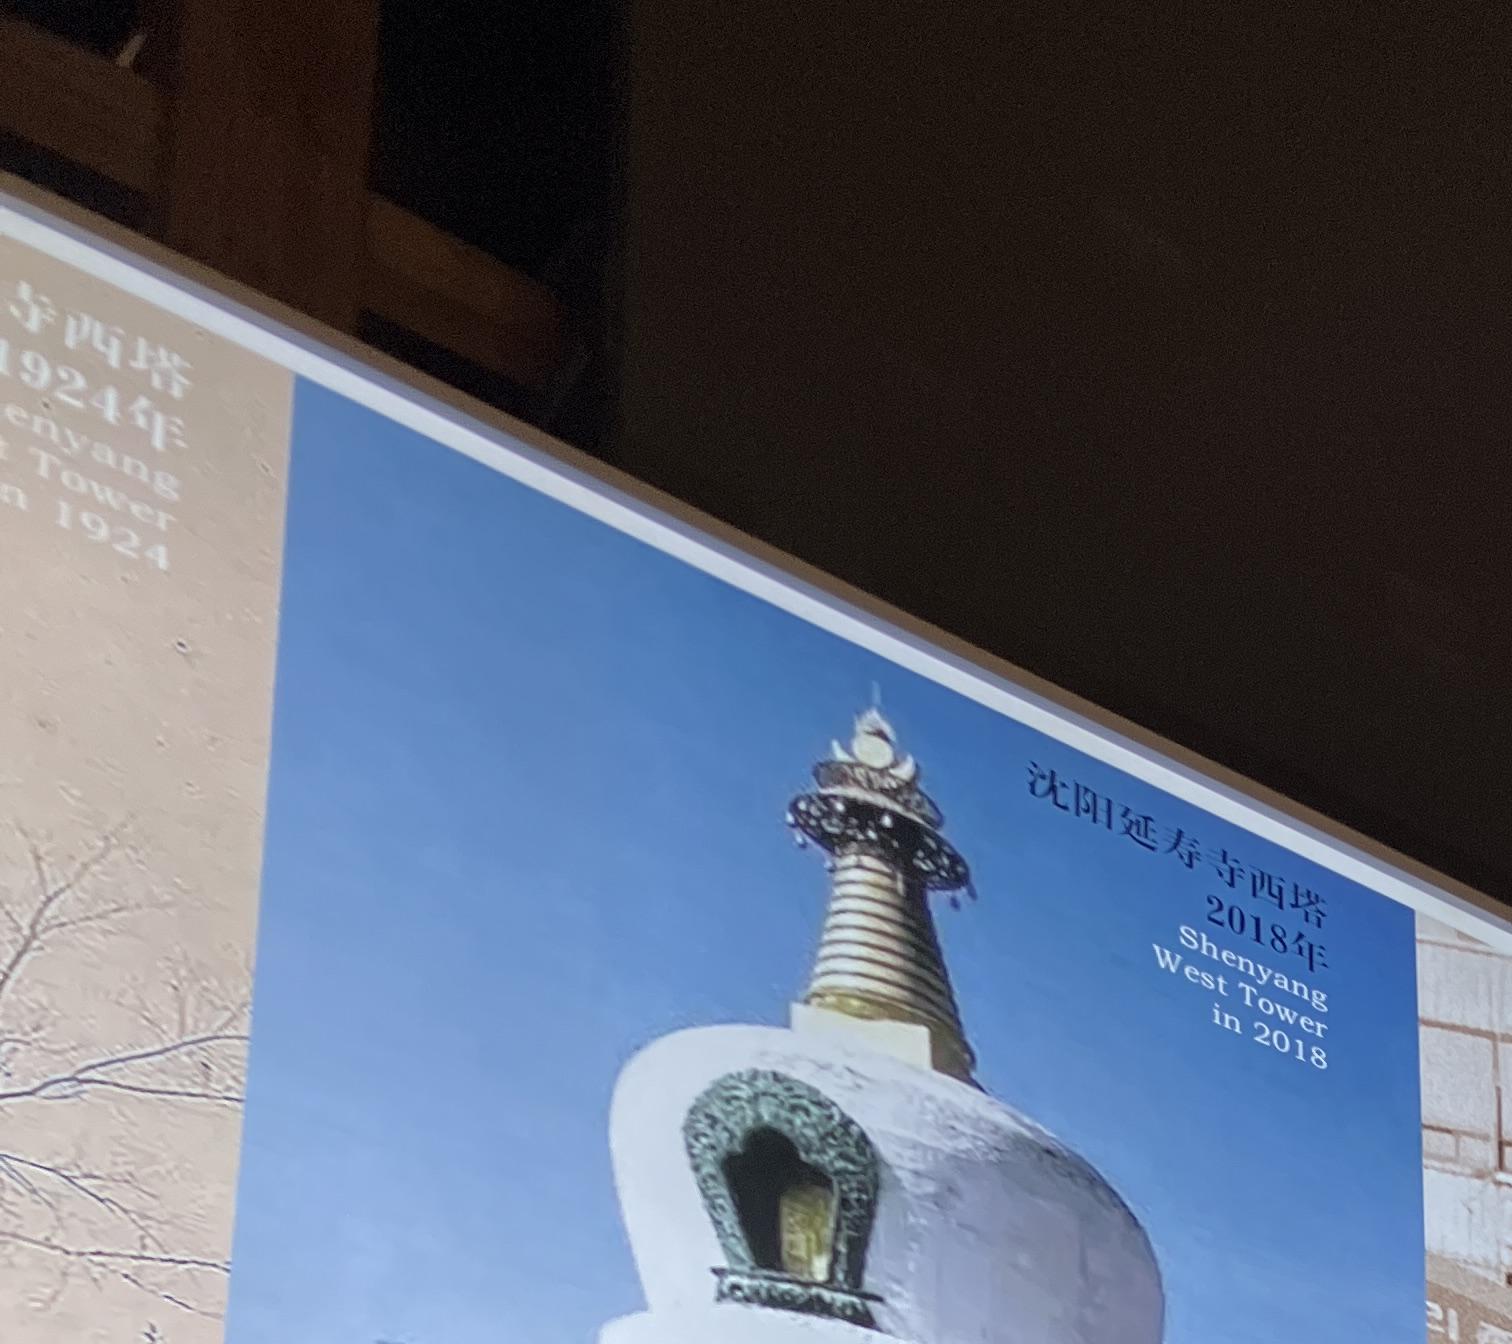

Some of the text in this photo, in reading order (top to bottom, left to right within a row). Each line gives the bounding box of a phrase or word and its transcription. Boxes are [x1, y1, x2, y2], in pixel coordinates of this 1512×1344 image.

[29, 447, 176, 531] Tower
[56, 500, 168, 571] 1924
[1025, 759, 1328, 930] 沈阳延寿寺西塔
[1178, 924, 1330, 1012] Shenyang
[1206, 894, 1330, 973] 2018年
[1152, 943, 1329, 1039] West Tower
[1212, 1003, 1329, 1070] in 2018
